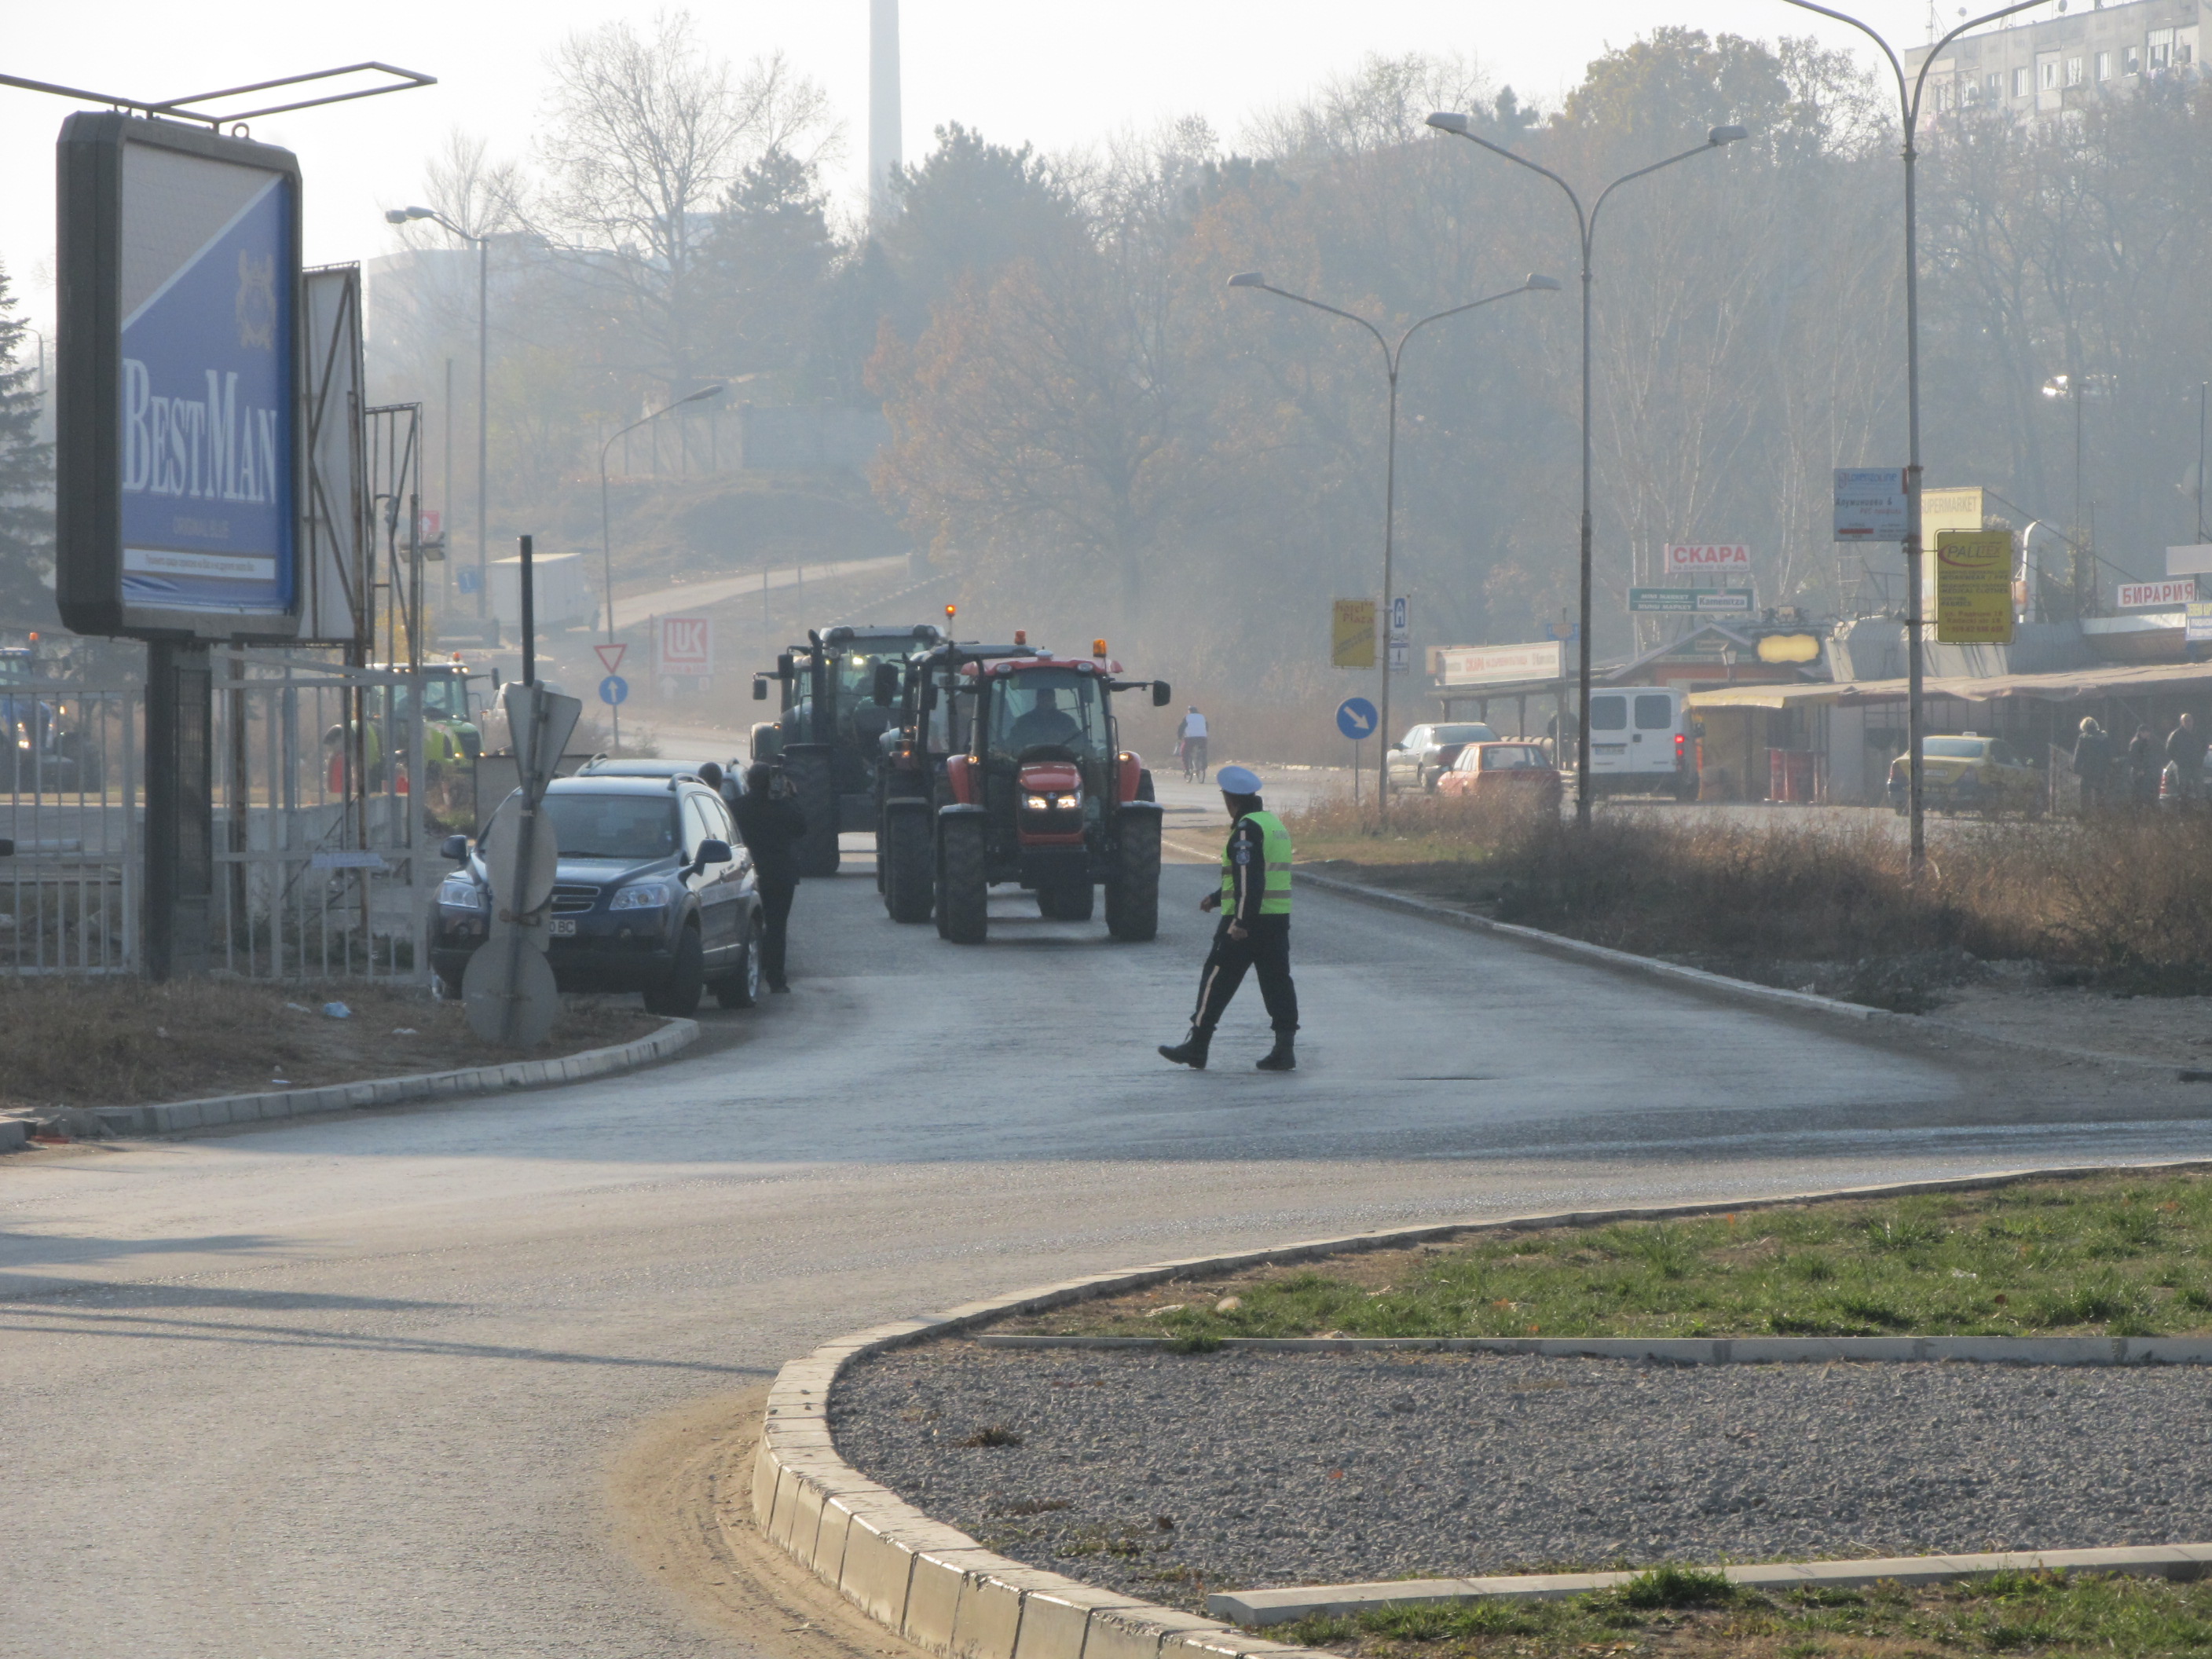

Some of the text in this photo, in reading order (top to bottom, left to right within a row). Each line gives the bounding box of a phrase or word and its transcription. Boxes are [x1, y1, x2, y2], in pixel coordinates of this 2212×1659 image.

[1673, 546, 1748, 564] СКАРА
[1698, 596, 1745, 606] Kamenitza
[2122, 583, 2194, 605] БИРАРИЯ
